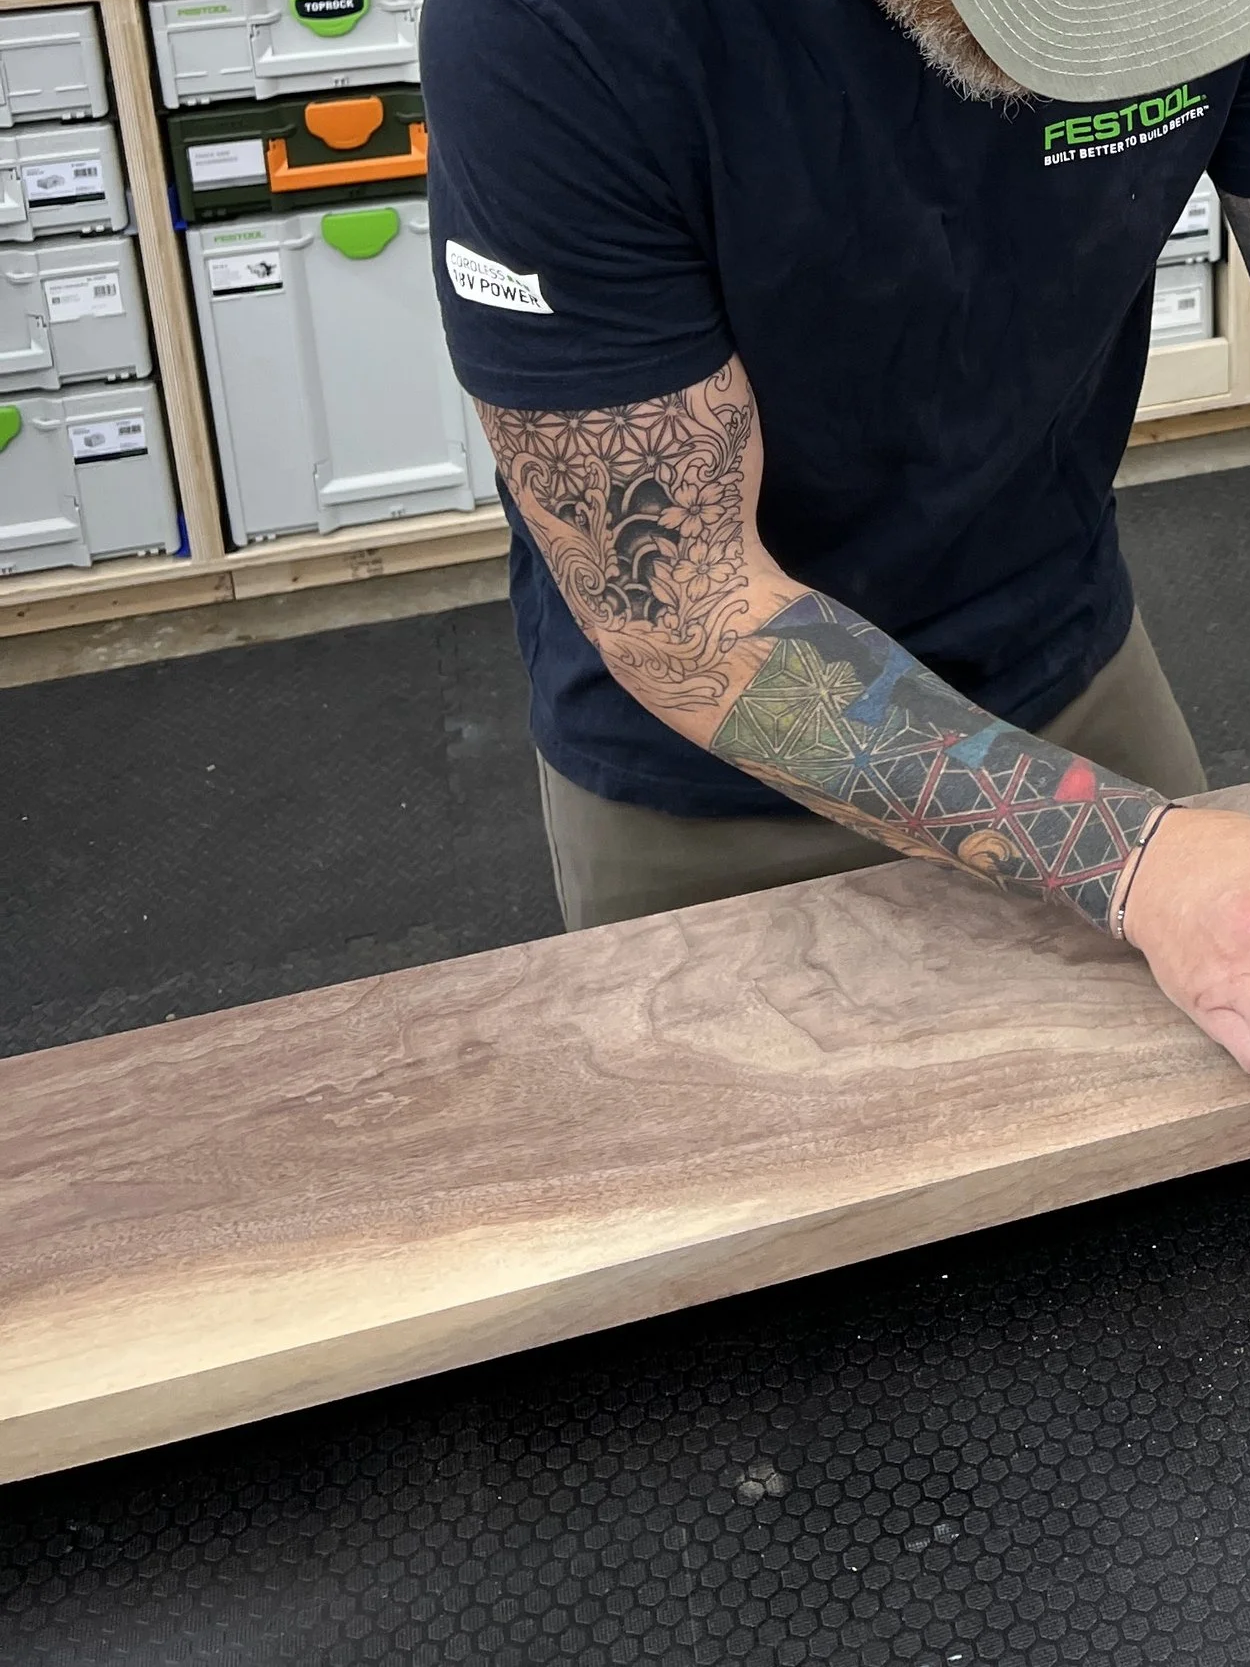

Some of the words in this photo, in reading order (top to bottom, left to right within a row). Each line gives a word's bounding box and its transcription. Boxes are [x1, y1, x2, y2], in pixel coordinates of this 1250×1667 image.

[1044, 84, 1202, 151] FESTOOL
[1044, 149, 1077, 166] BUILT
[1079, 142, 1124, 159] BETTER
[1125, 135, 1137, 148] TO
[1139, 124, 1169, 144] BUILD
[450, 252, 506, 282] CORDLESS
[453, 269, 475, 290] 18V
[480, 278, 541, 308] POWER
